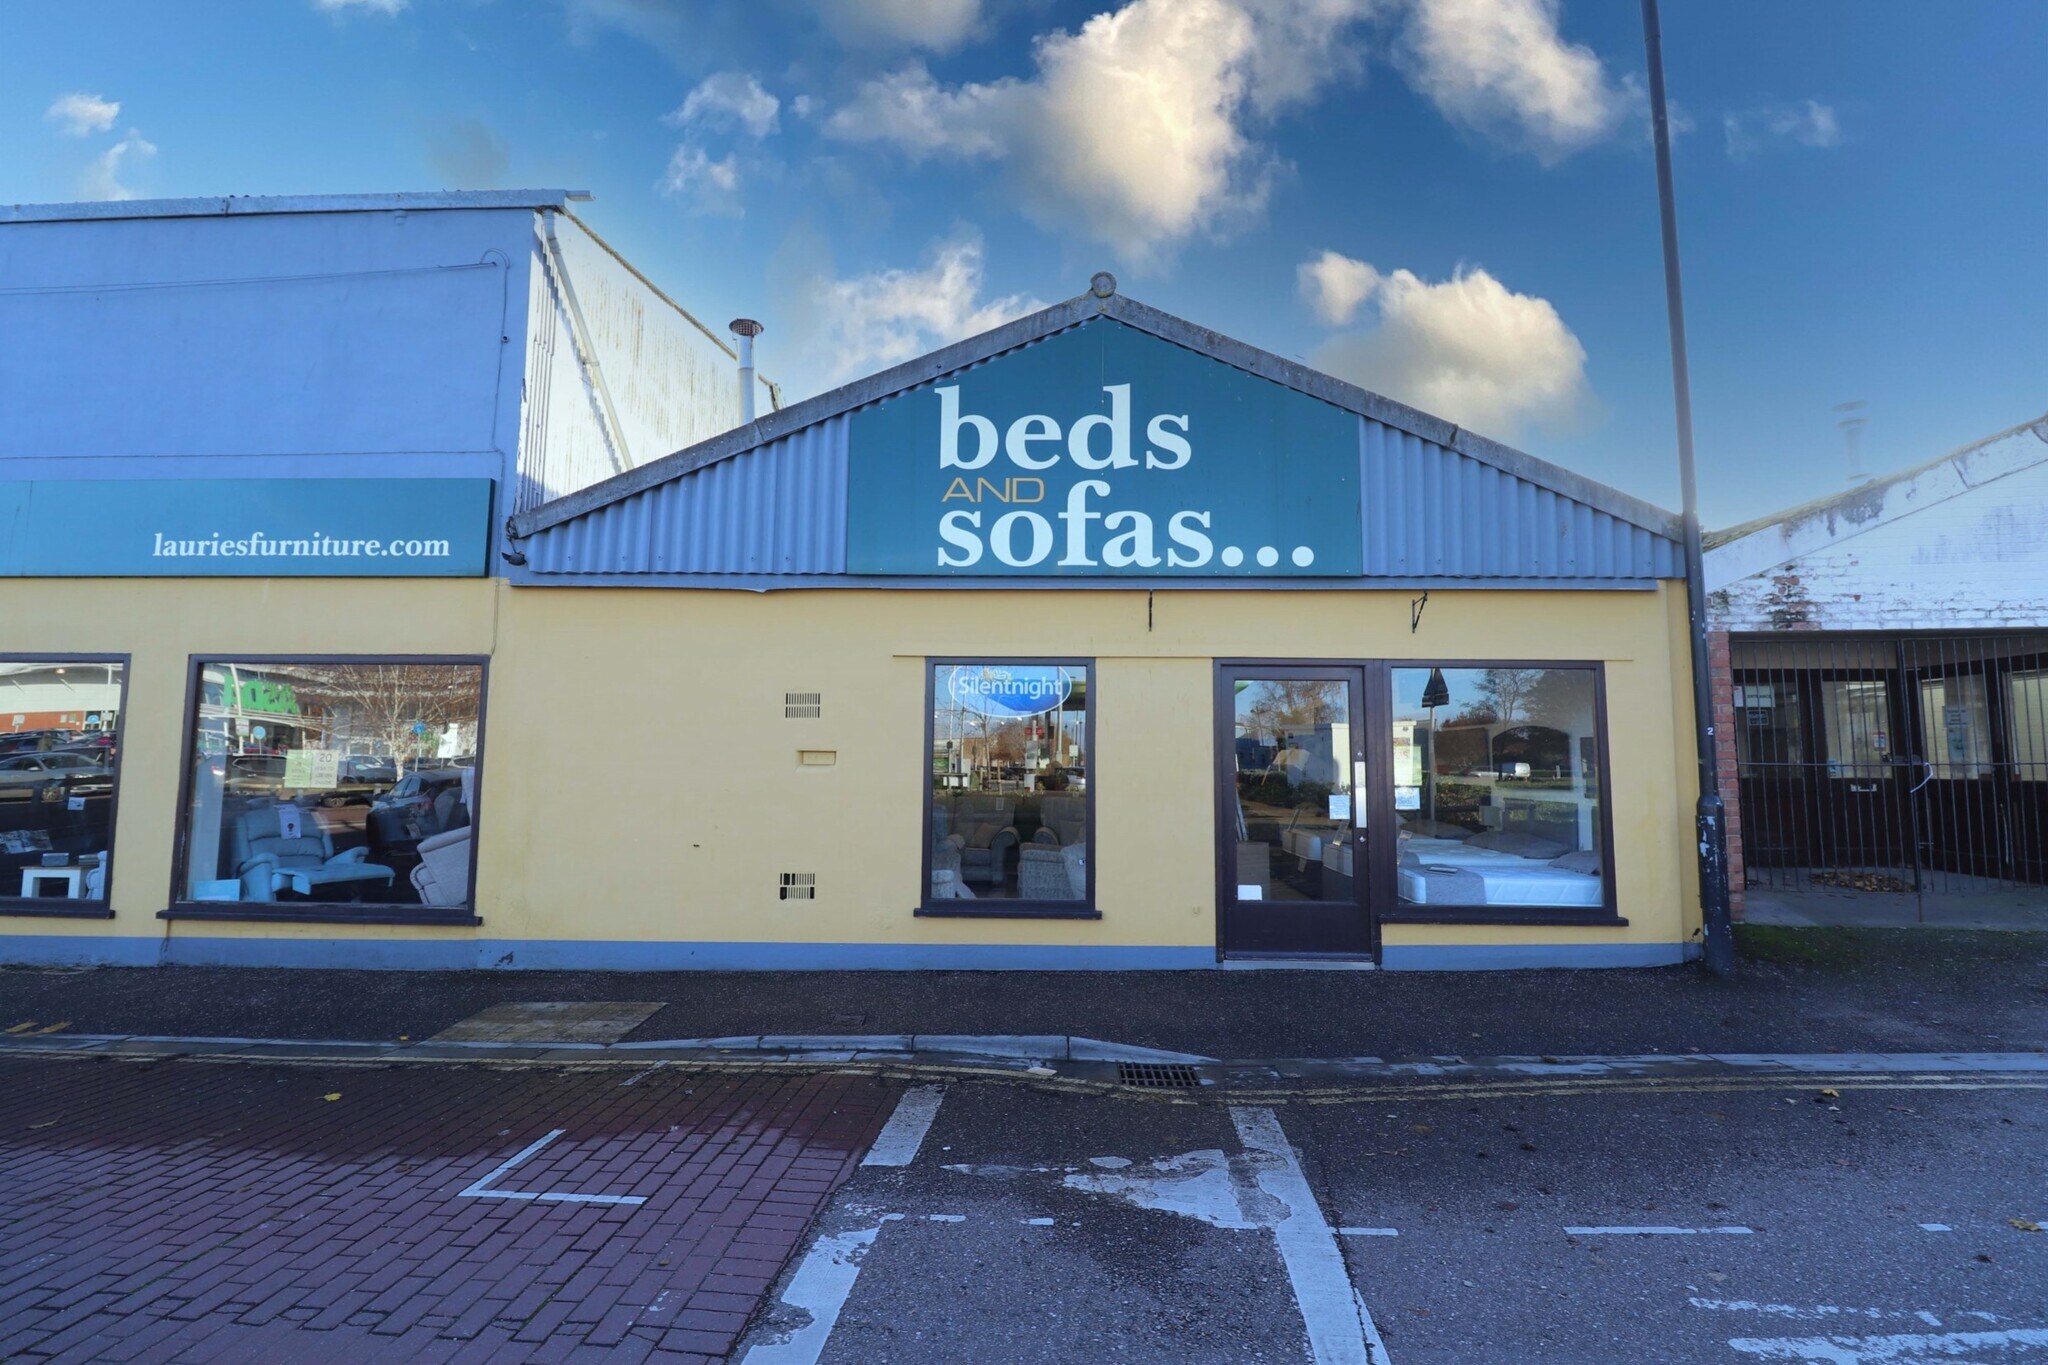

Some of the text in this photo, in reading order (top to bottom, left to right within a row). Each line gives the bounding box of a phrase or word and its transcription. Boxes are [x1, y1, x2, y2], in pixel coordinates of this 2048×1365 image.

[934, 384, 1192, 470] beds
[942, 477, 1045, 503] AND
[937, 480, 1315, 568] sofas...
[152, 531, 450, 558] lauriesfurniture.com
[958, 676, 1062, 700] Silentnight
[1707, 727, 1714, 736] 2
